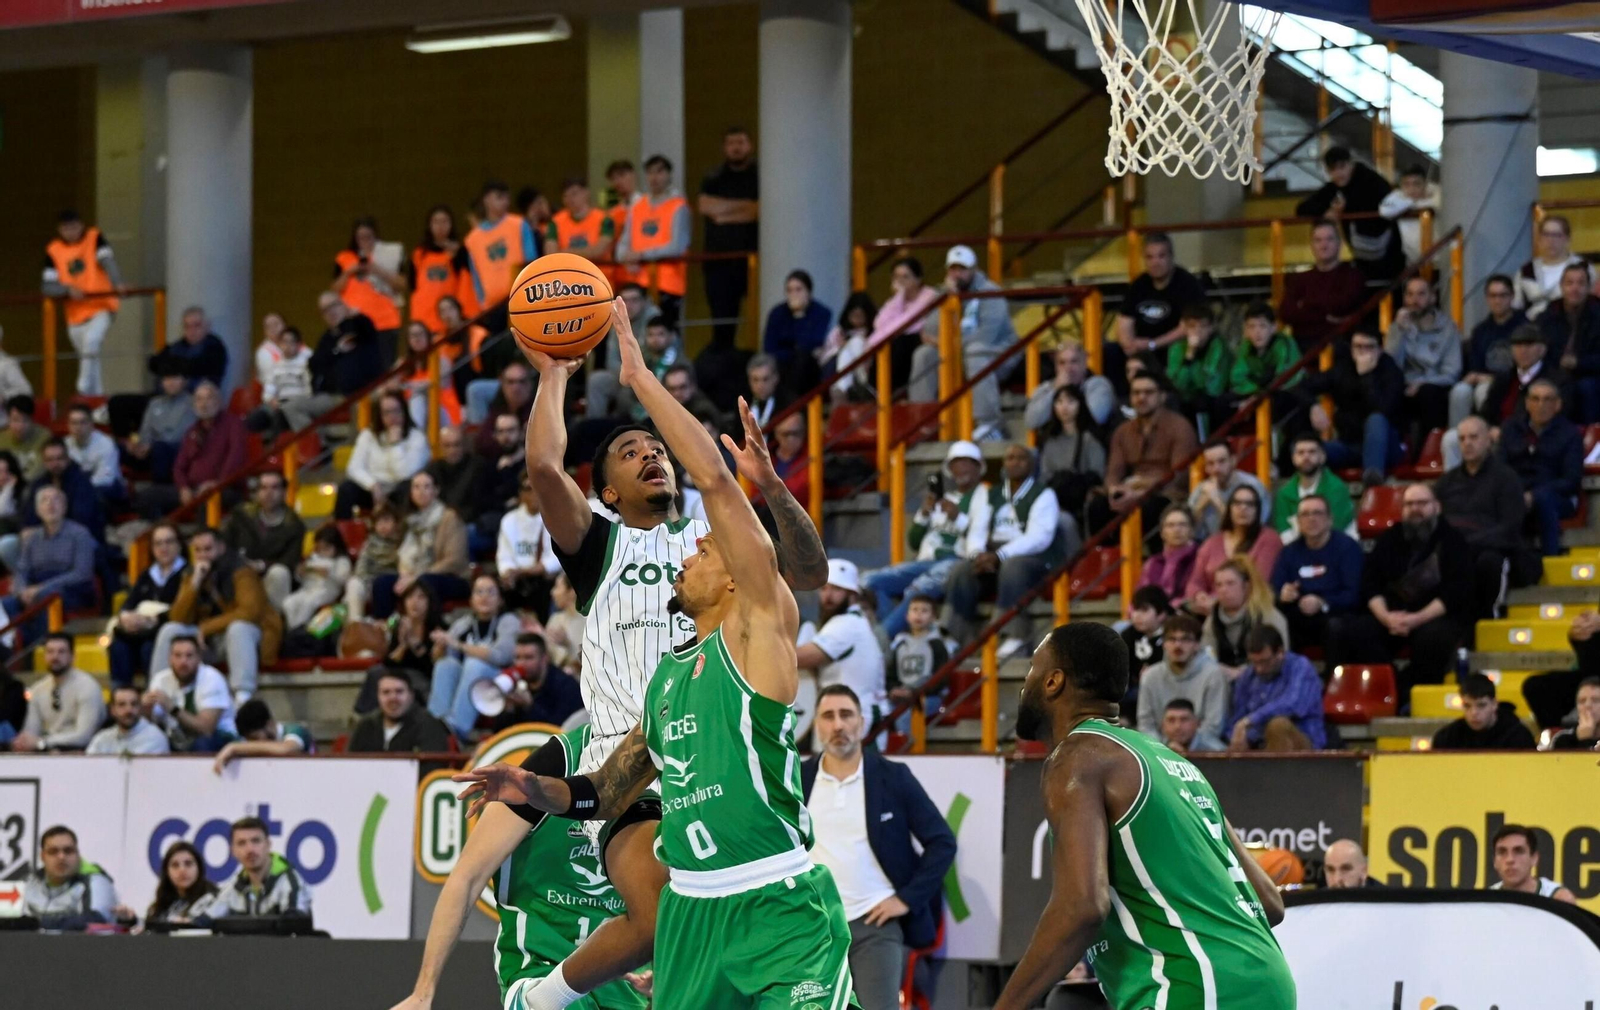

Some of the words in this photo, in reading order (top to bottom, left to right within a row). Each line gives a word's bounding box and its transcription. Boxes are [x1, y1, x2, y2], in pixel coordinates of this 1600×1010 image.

[524, 279, 595, 304] Wilson
[542, 318, 584, 335] EVO
[619, 561, 678, 586] cot
[615, 618, 667, 632] Fundación
[685, 820, 719, 860] 0
